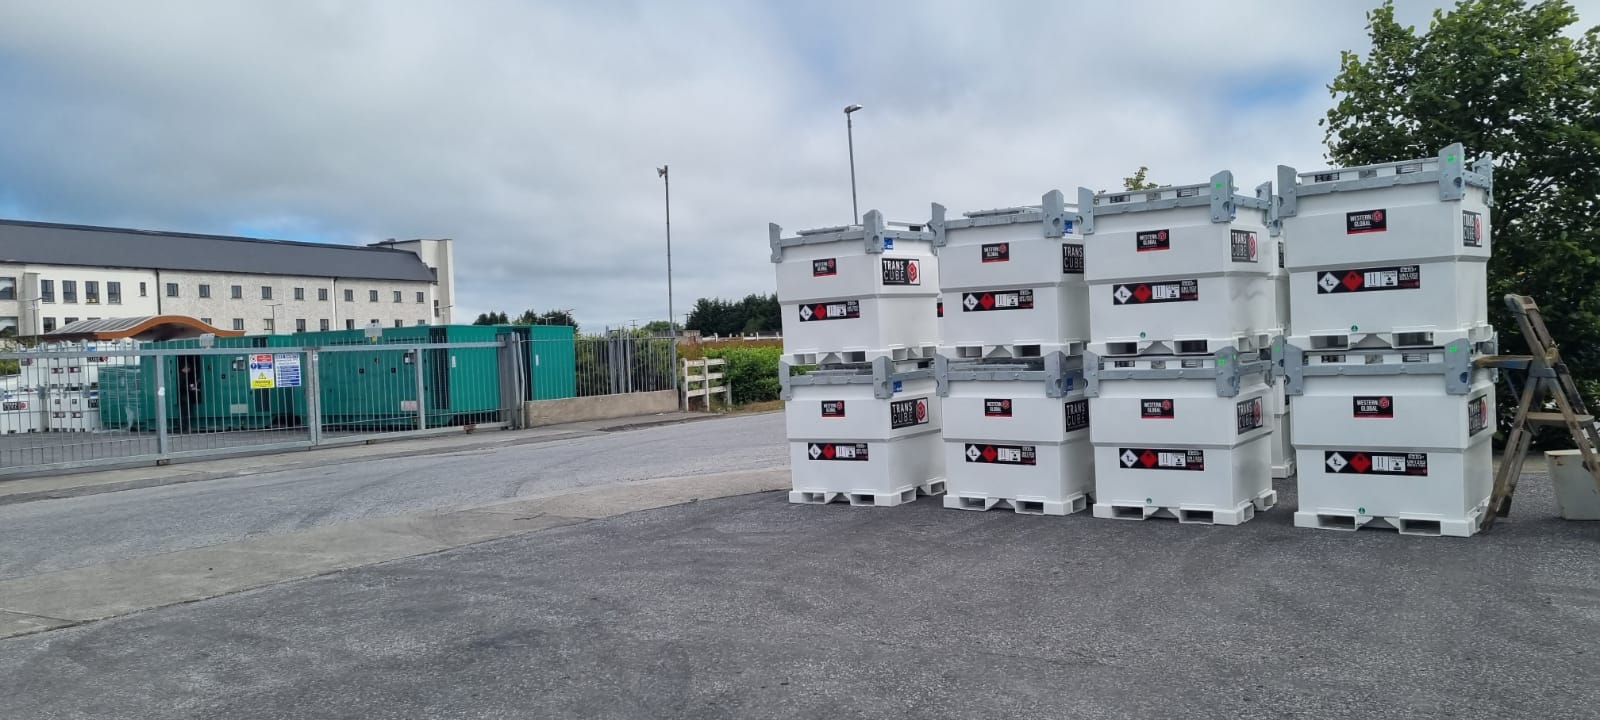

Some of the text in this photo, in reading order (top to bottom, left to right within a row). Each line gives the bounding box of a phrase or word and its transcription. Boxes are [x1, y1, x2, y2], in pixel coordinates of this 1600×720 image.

[1350, 214, 1372, 222] WESTERN
[1232, 232, 1248, 245] TRANS
[1063, 246, 1083, 258] TRANS
[1232, 244, 1248, 257] CUBE
[883, 260, 905, 271] TRANS
[1064, 257, 1083, 269] CUBE
[884, 270, 905, 281] CUBE
[892, 402, 913, 414] TRANS
[1066, 401, 1086, 416] TRANS
[1238, 402, 1253, 416] TRANS
[892, 412, 913, 424] CUBE
[1066, 412, 1086, 427] CUBE
[1239, 413, 1253, 429] CUBE
